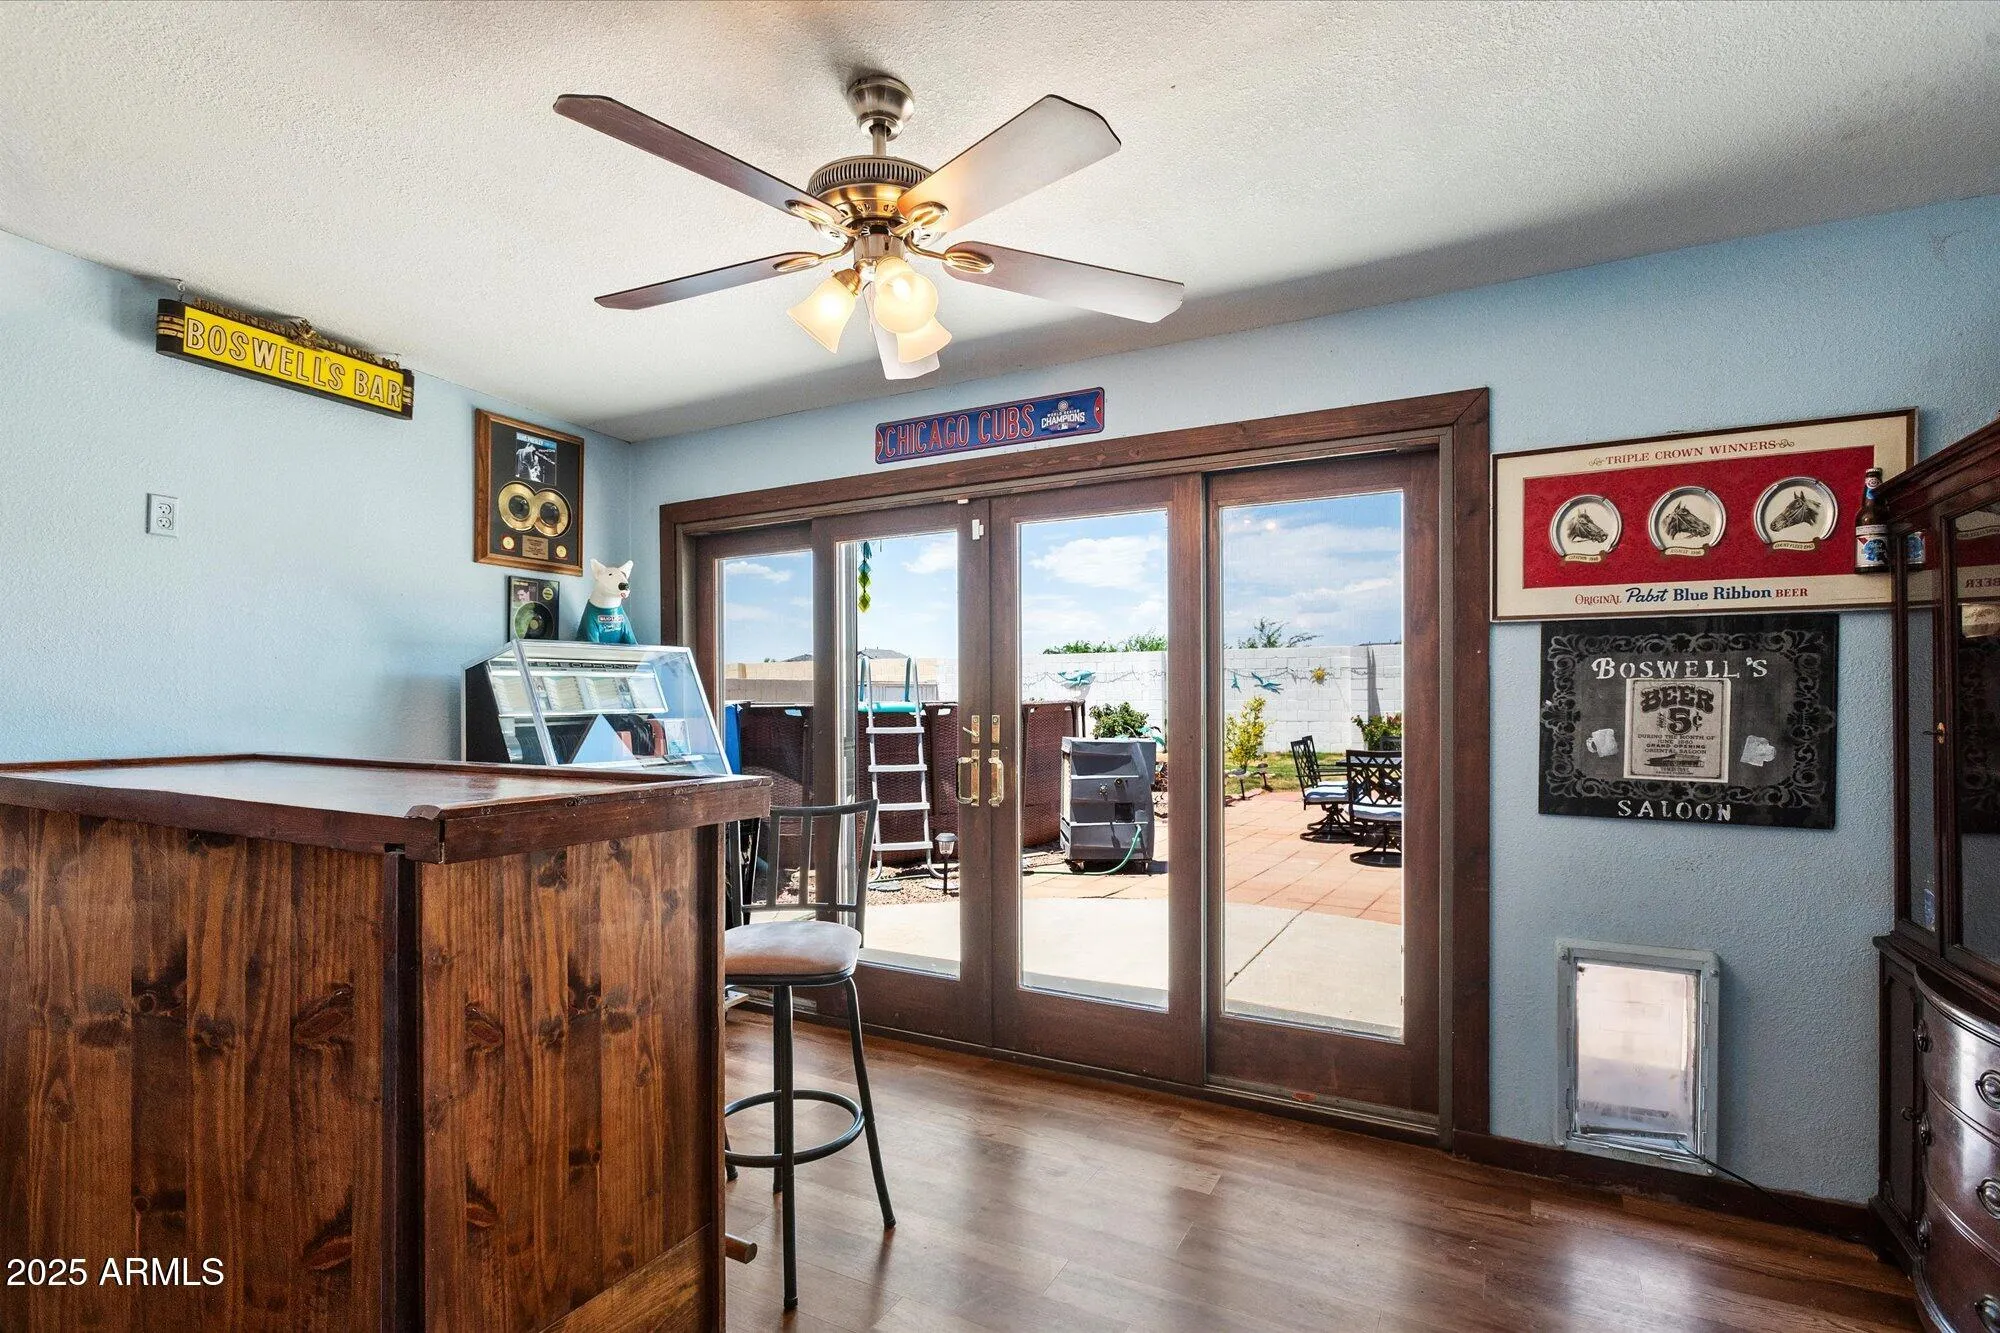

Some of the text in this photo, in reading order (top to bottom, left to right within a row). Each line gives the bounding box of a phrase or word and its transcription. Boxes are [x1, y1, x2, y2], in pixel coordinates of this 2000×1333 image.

[186, 317, 402, 409] BOSWELL'S BAR
[884, 404, 1035, 458] CHICAGO CUBS
[1041, 411, 1085, 429] CHAMPIONS
[1605, 439, 1778, 465] TRIPLE CROWN WINNERS
[1574, 585, 1808, 606] ORIGINAL Pabst Blue Ribbon BEER
[1591, 656, 1768, 680] BOSWELL'S
[1640, 684, 1715, 714] BEER
[1667, 706, 1703, 735] 5¢
[1617, 799, 1732, 822] SALOON
